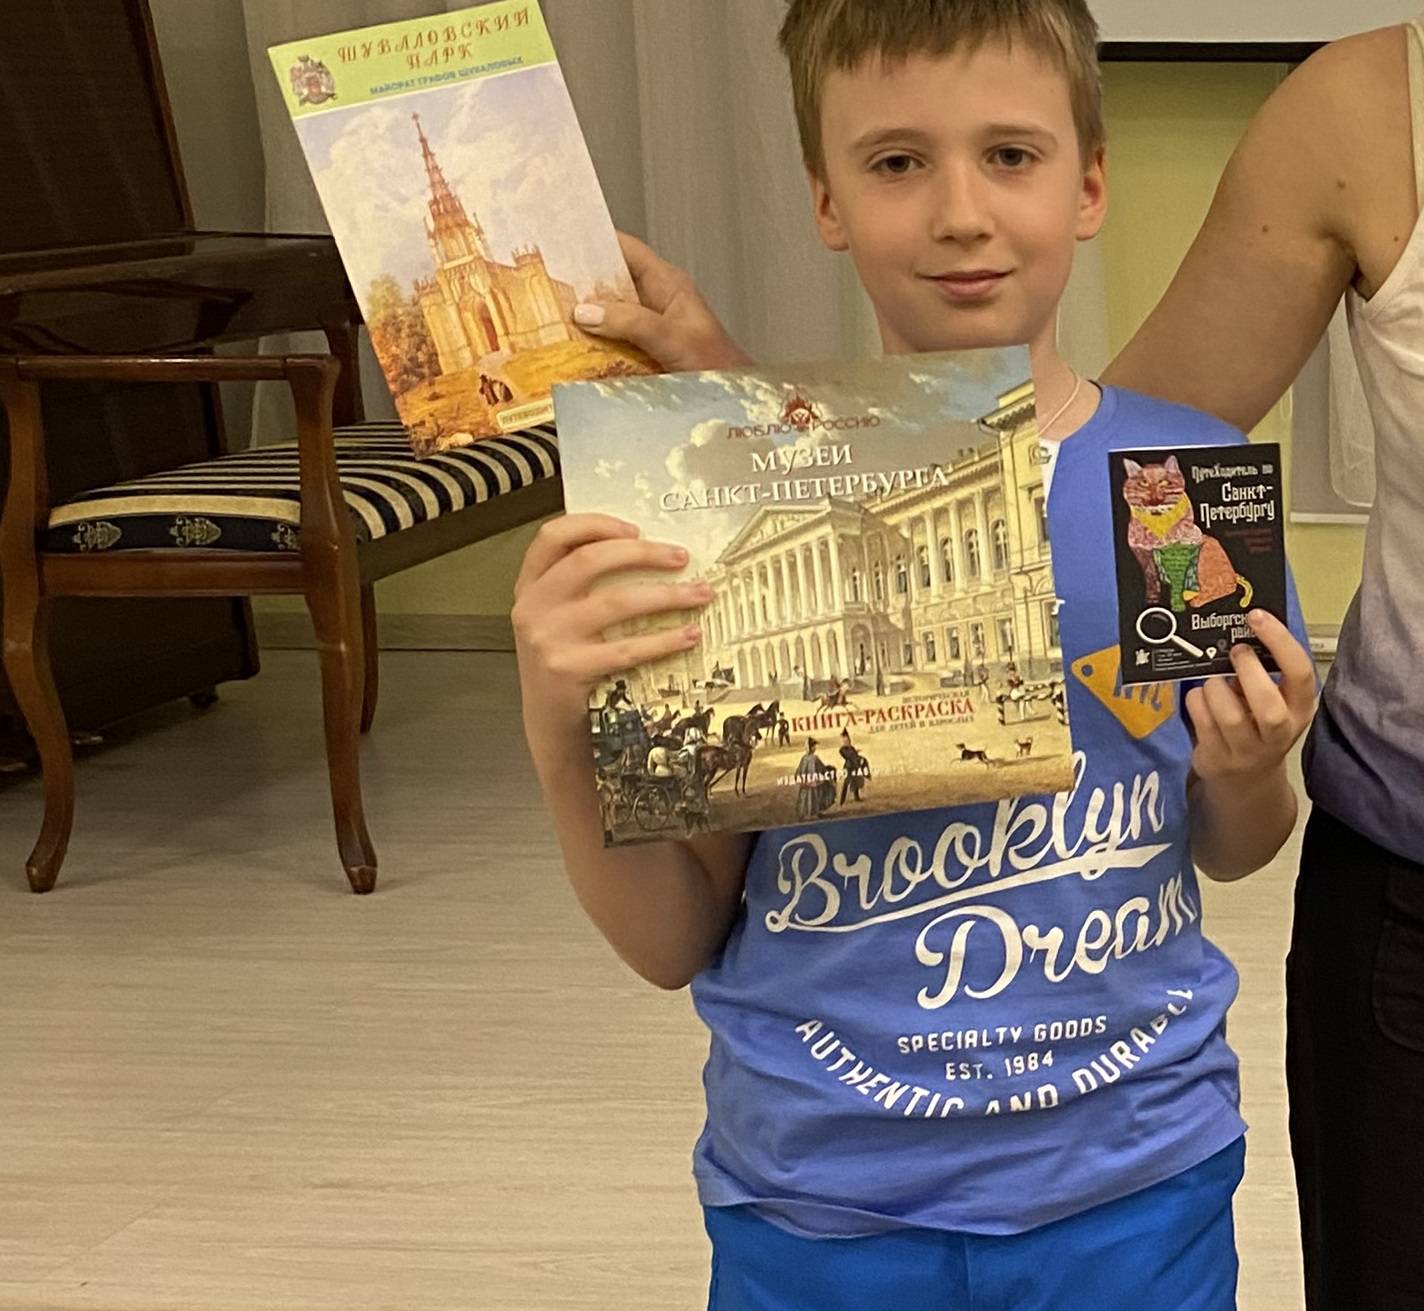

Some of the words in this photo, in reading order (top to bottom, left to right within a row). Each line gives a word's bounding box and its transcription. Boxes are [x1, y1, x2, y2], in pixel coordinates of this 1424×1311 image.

[337, 7, 530, 64] ШУВАЛОВСКИЙ
[406, 43, 474, 70] ПАРК
[751, 444, 853, 476] МУЗЕИ
[658, 465, 950, 513] САНКТ-ПЕТЕРБУРГА
[1221, 482, 1274, 502] Санкт-
[1199, 500, 1275, 529] Петербургу
[1191, 613, 1250, 630] Выборгск
[791, 698, 976, 733] КНИГА-РАСКРАСКА
[765, 750, 1168, 933] Brooklyn
[897, 1028, 1023, 1054] SPECIALTY
[1034, 1015, 1107, 1043] GOODS
[945, 1062, 993, 1081] EST.
[1004, 1051, 1055, 1077] 1984
